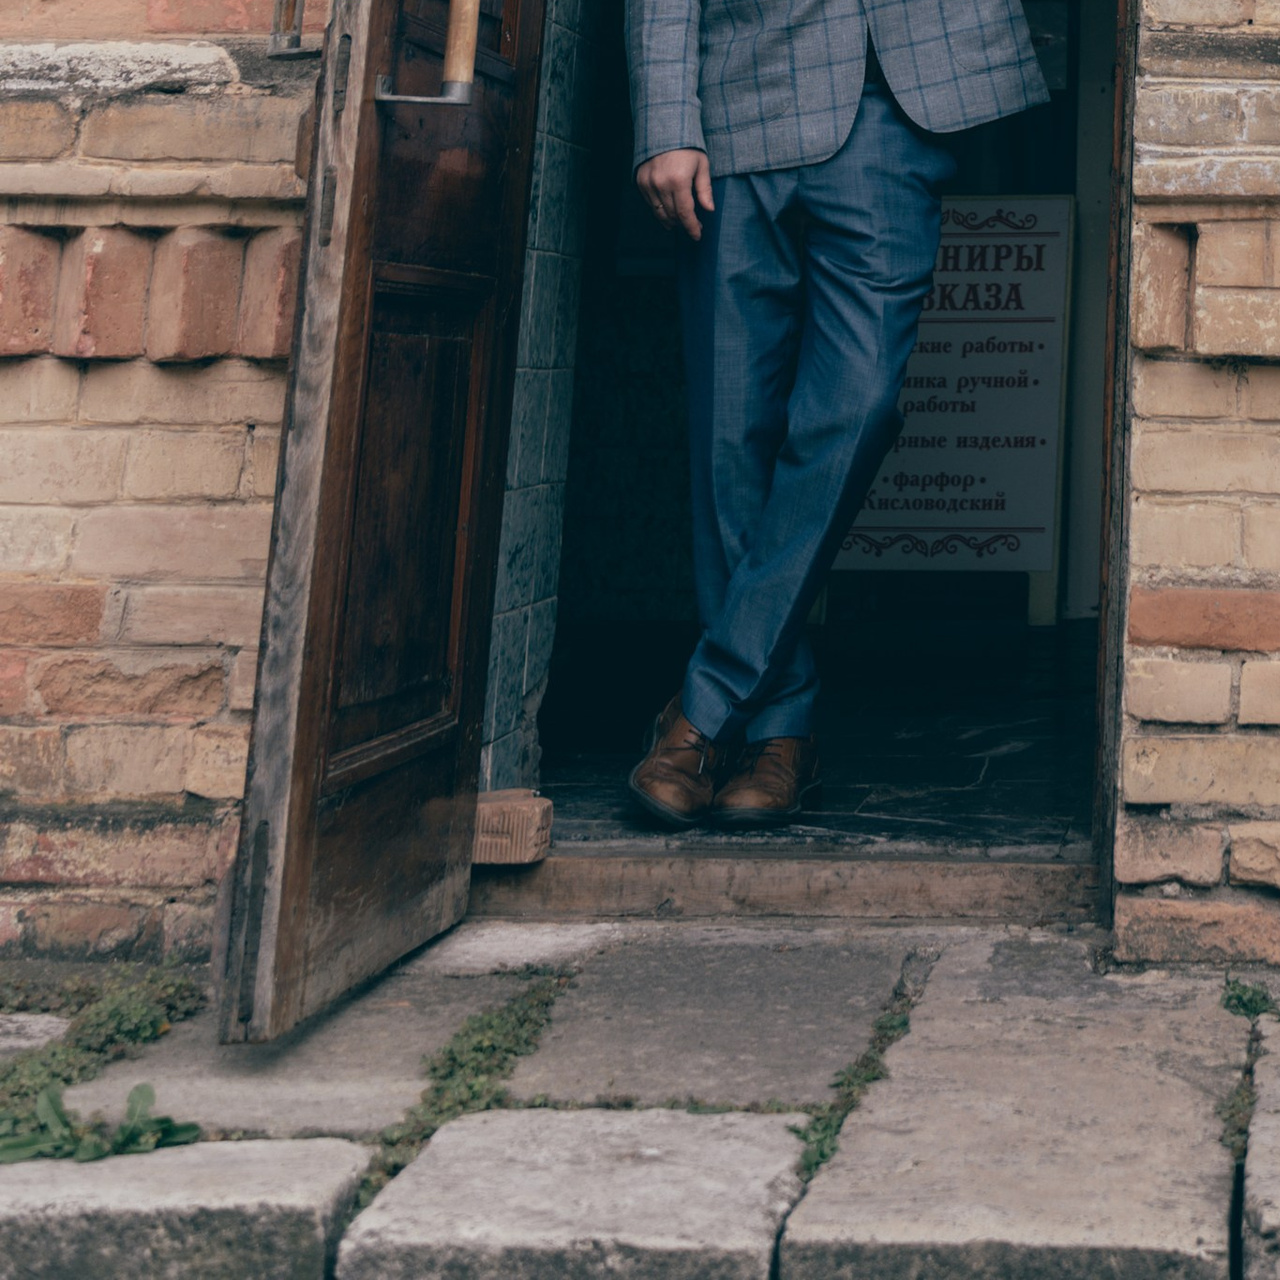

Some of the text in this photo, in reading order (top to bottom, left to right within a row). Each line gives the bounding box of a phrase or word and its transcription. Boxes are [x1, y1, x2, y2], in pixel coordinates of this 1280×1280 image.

[933, 243, 1047, 273] НИРЫ
[921, 282, 1026, 312] ВКАЗА
[961, 335, 1035, 359] работы
[956, 368, 1029, 394] ручной
[902, 395, 977, 418] работы
[955, 435, 1037, 452] изделия
[892, 471, 975, 492] фарфор
[862, 489, 1007, 514] Кисловодский
